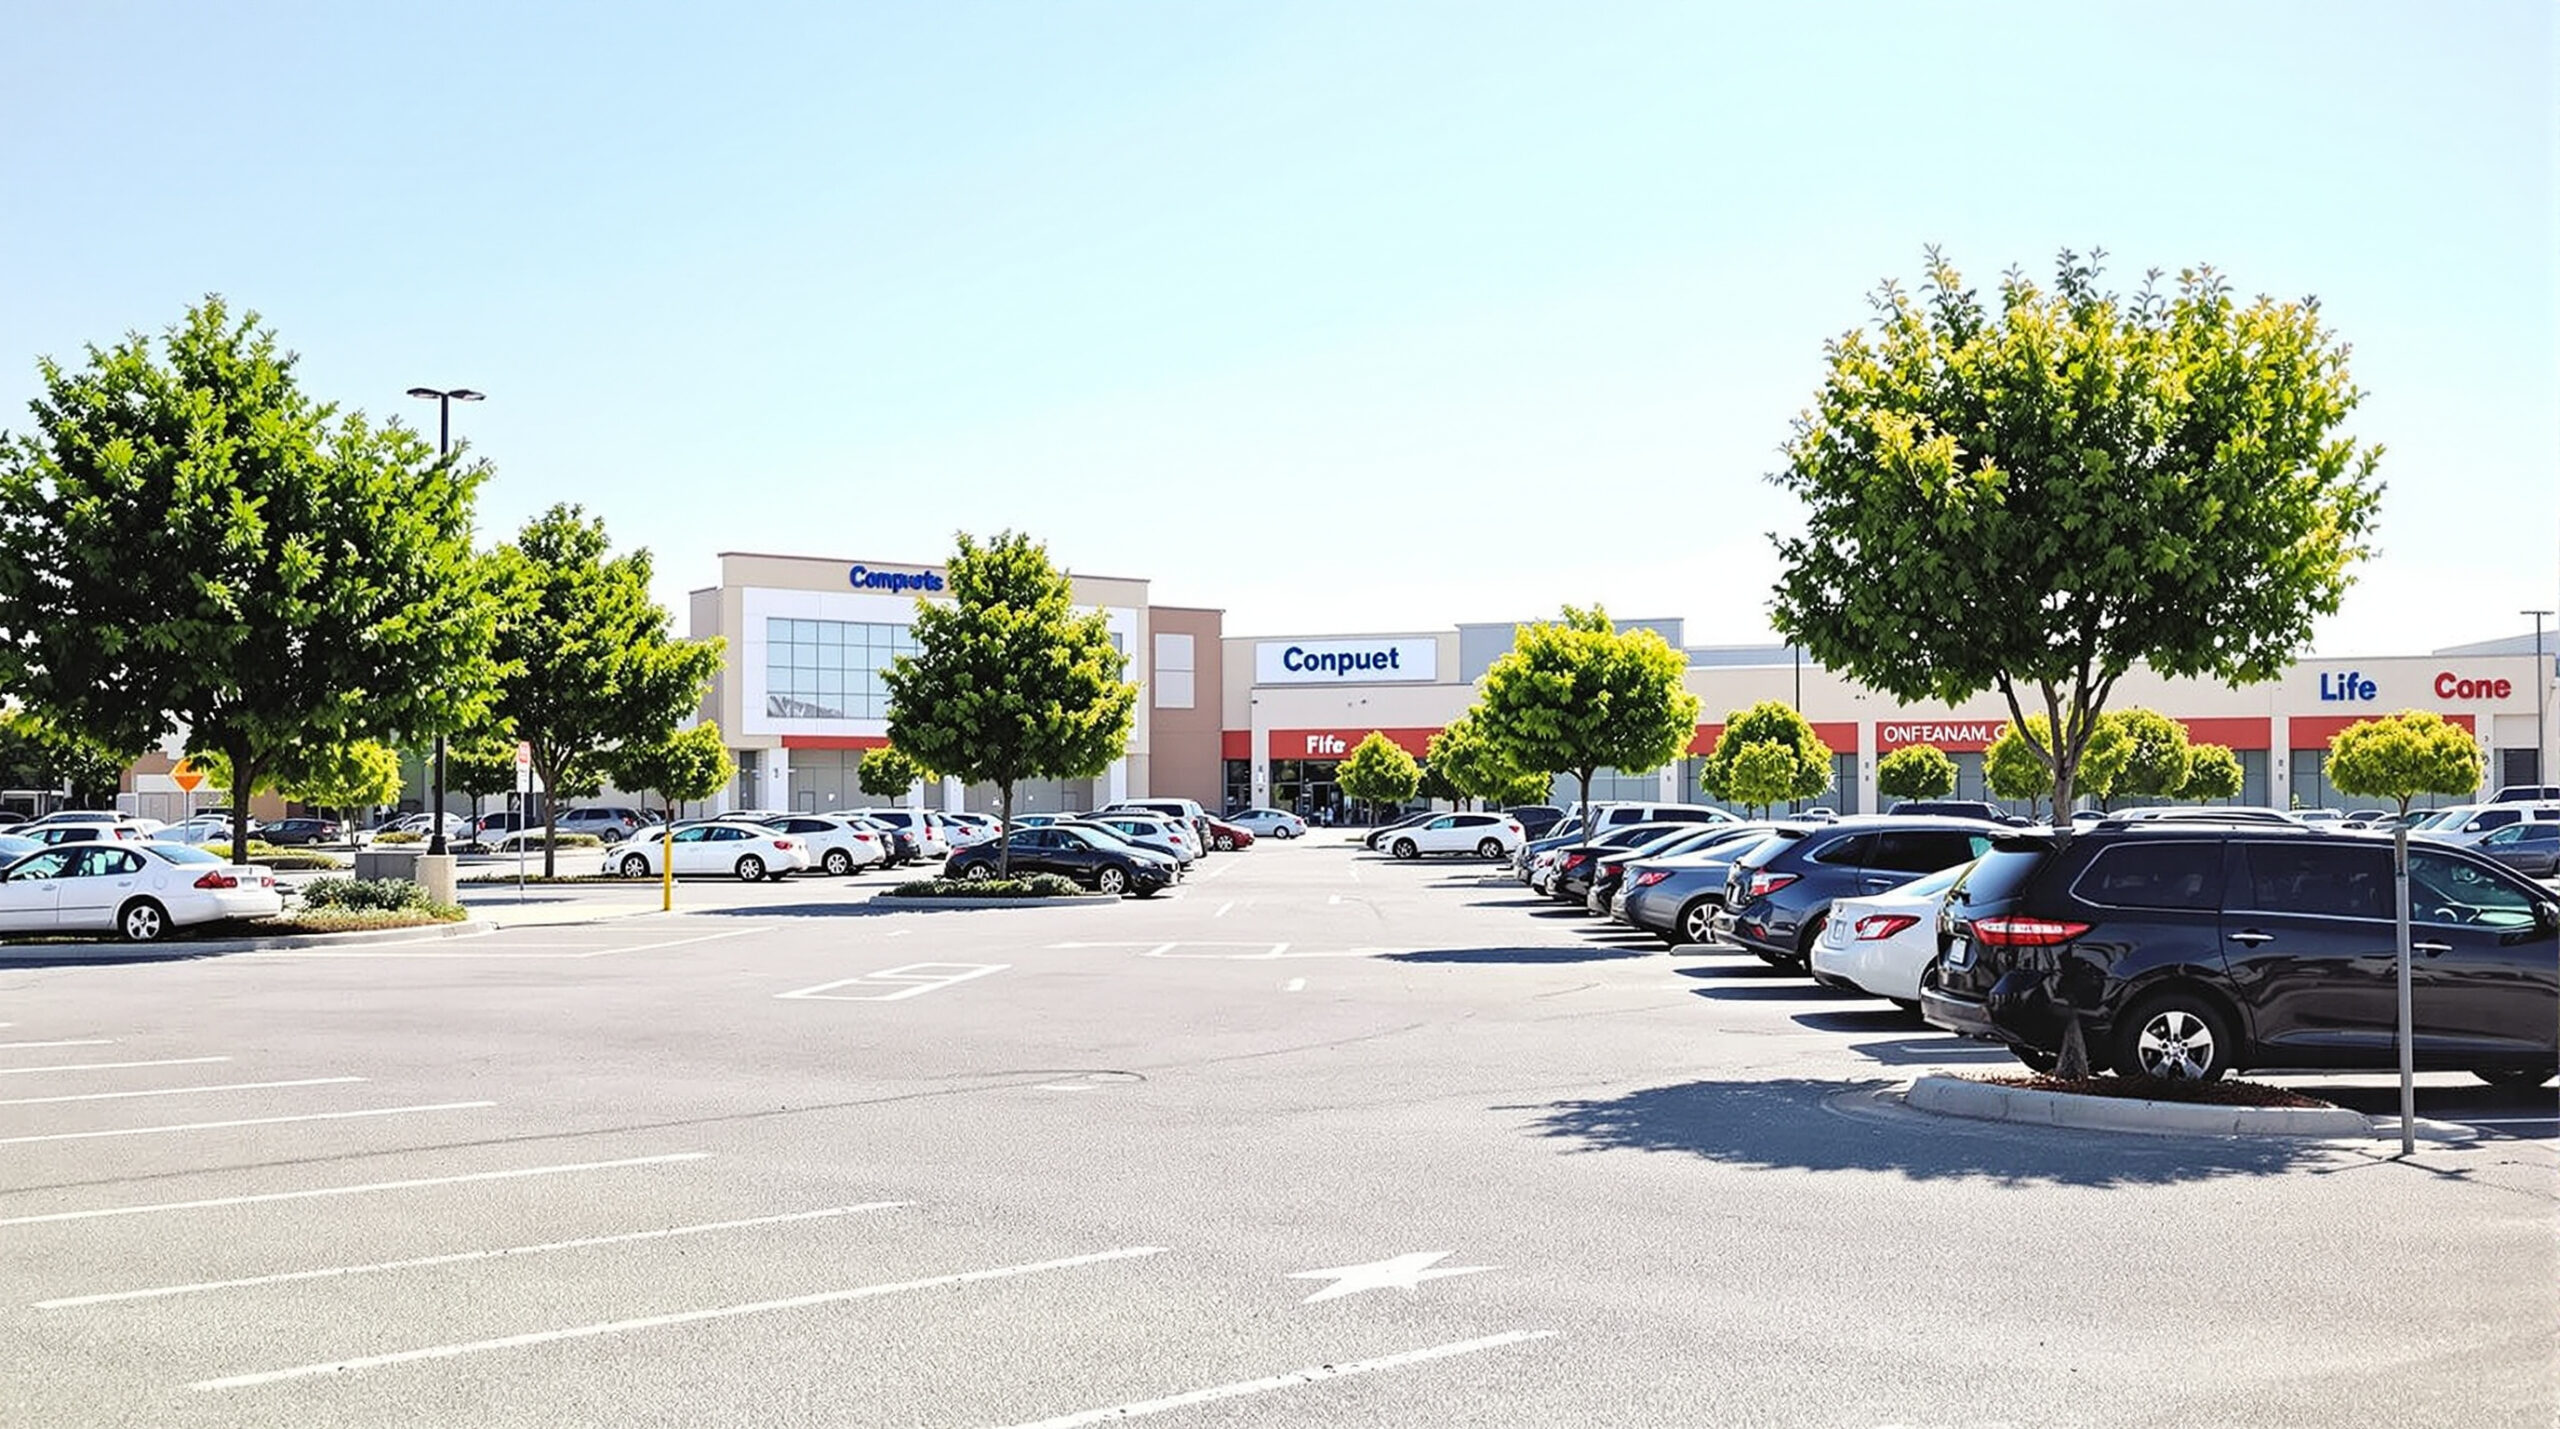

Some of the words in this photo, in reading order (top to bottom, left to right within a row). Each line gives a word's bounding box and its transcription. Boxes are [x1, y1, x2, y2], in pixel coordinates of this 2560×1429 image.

[1283, 646, 1400, 676] Conpuet
[2320, 672, 2377, 701] Life
[2434, 671, 2512, 700] Cone
